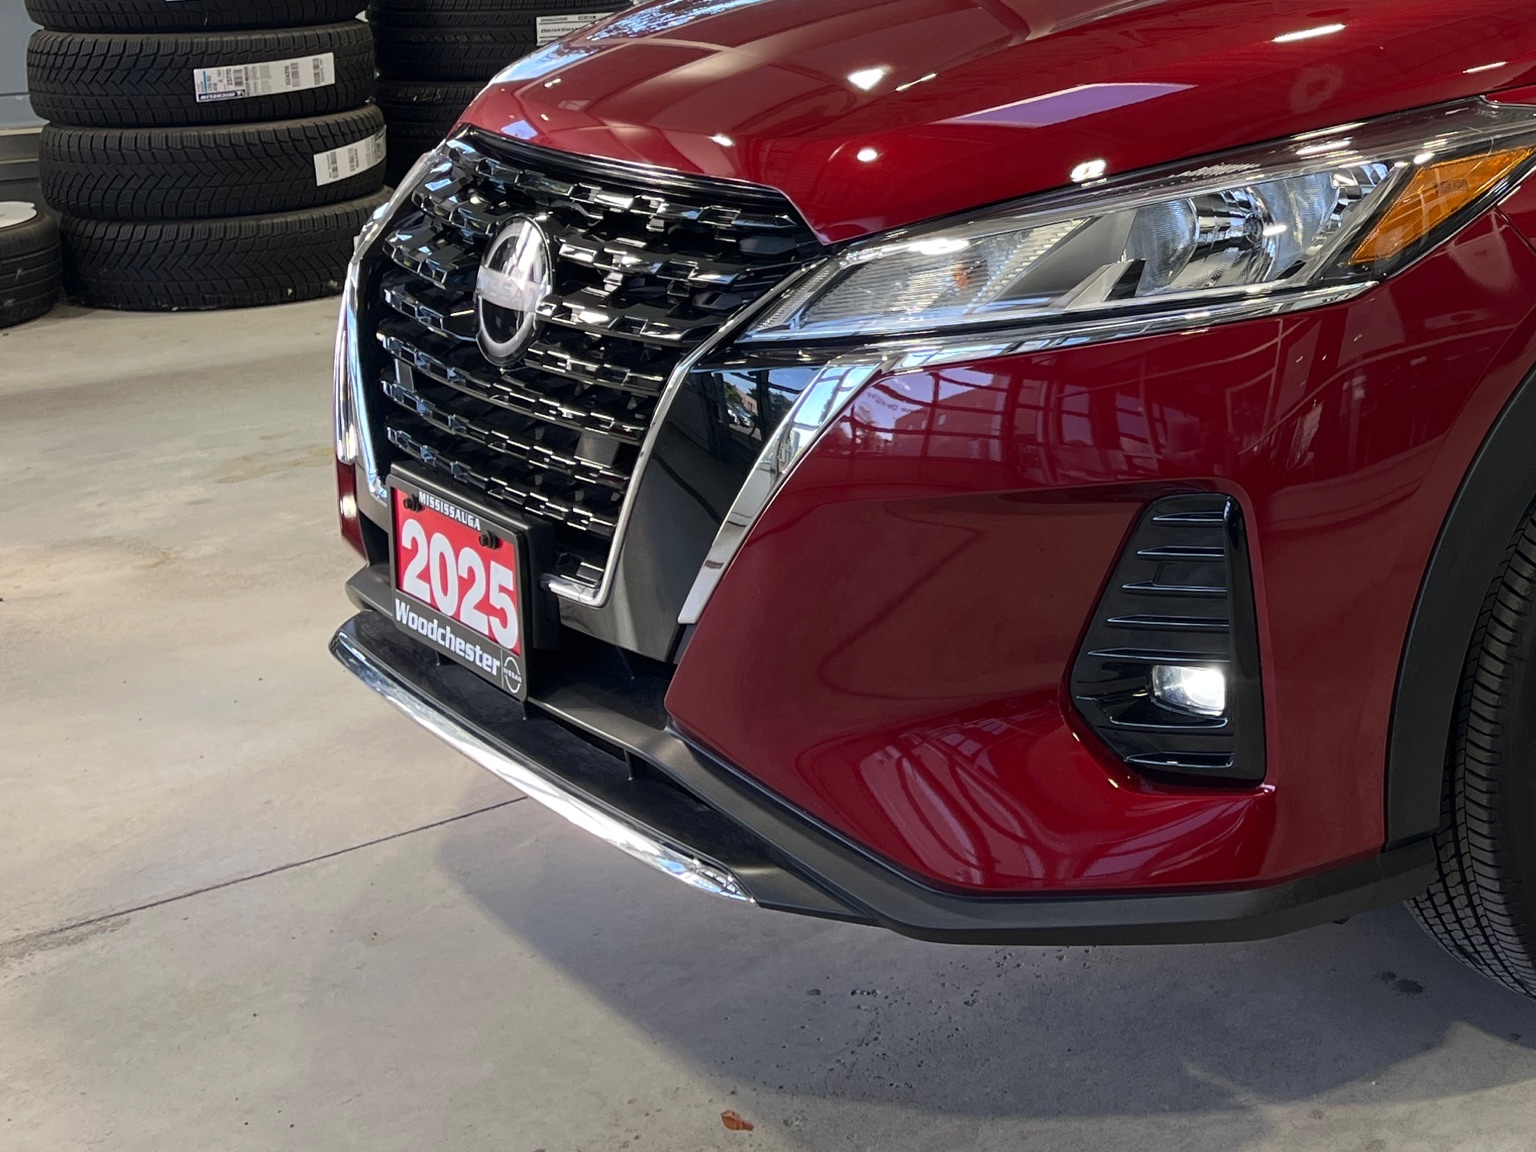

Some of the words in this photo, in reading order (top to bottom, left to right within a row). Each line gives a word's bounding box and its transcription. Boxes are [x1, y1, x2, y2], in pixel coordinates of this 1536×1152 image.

[419, 491, 481, 531] MISSISSAUGA
[401, 518, 518, 649] 2025
[395, 598, 501, 676] Woodchester
